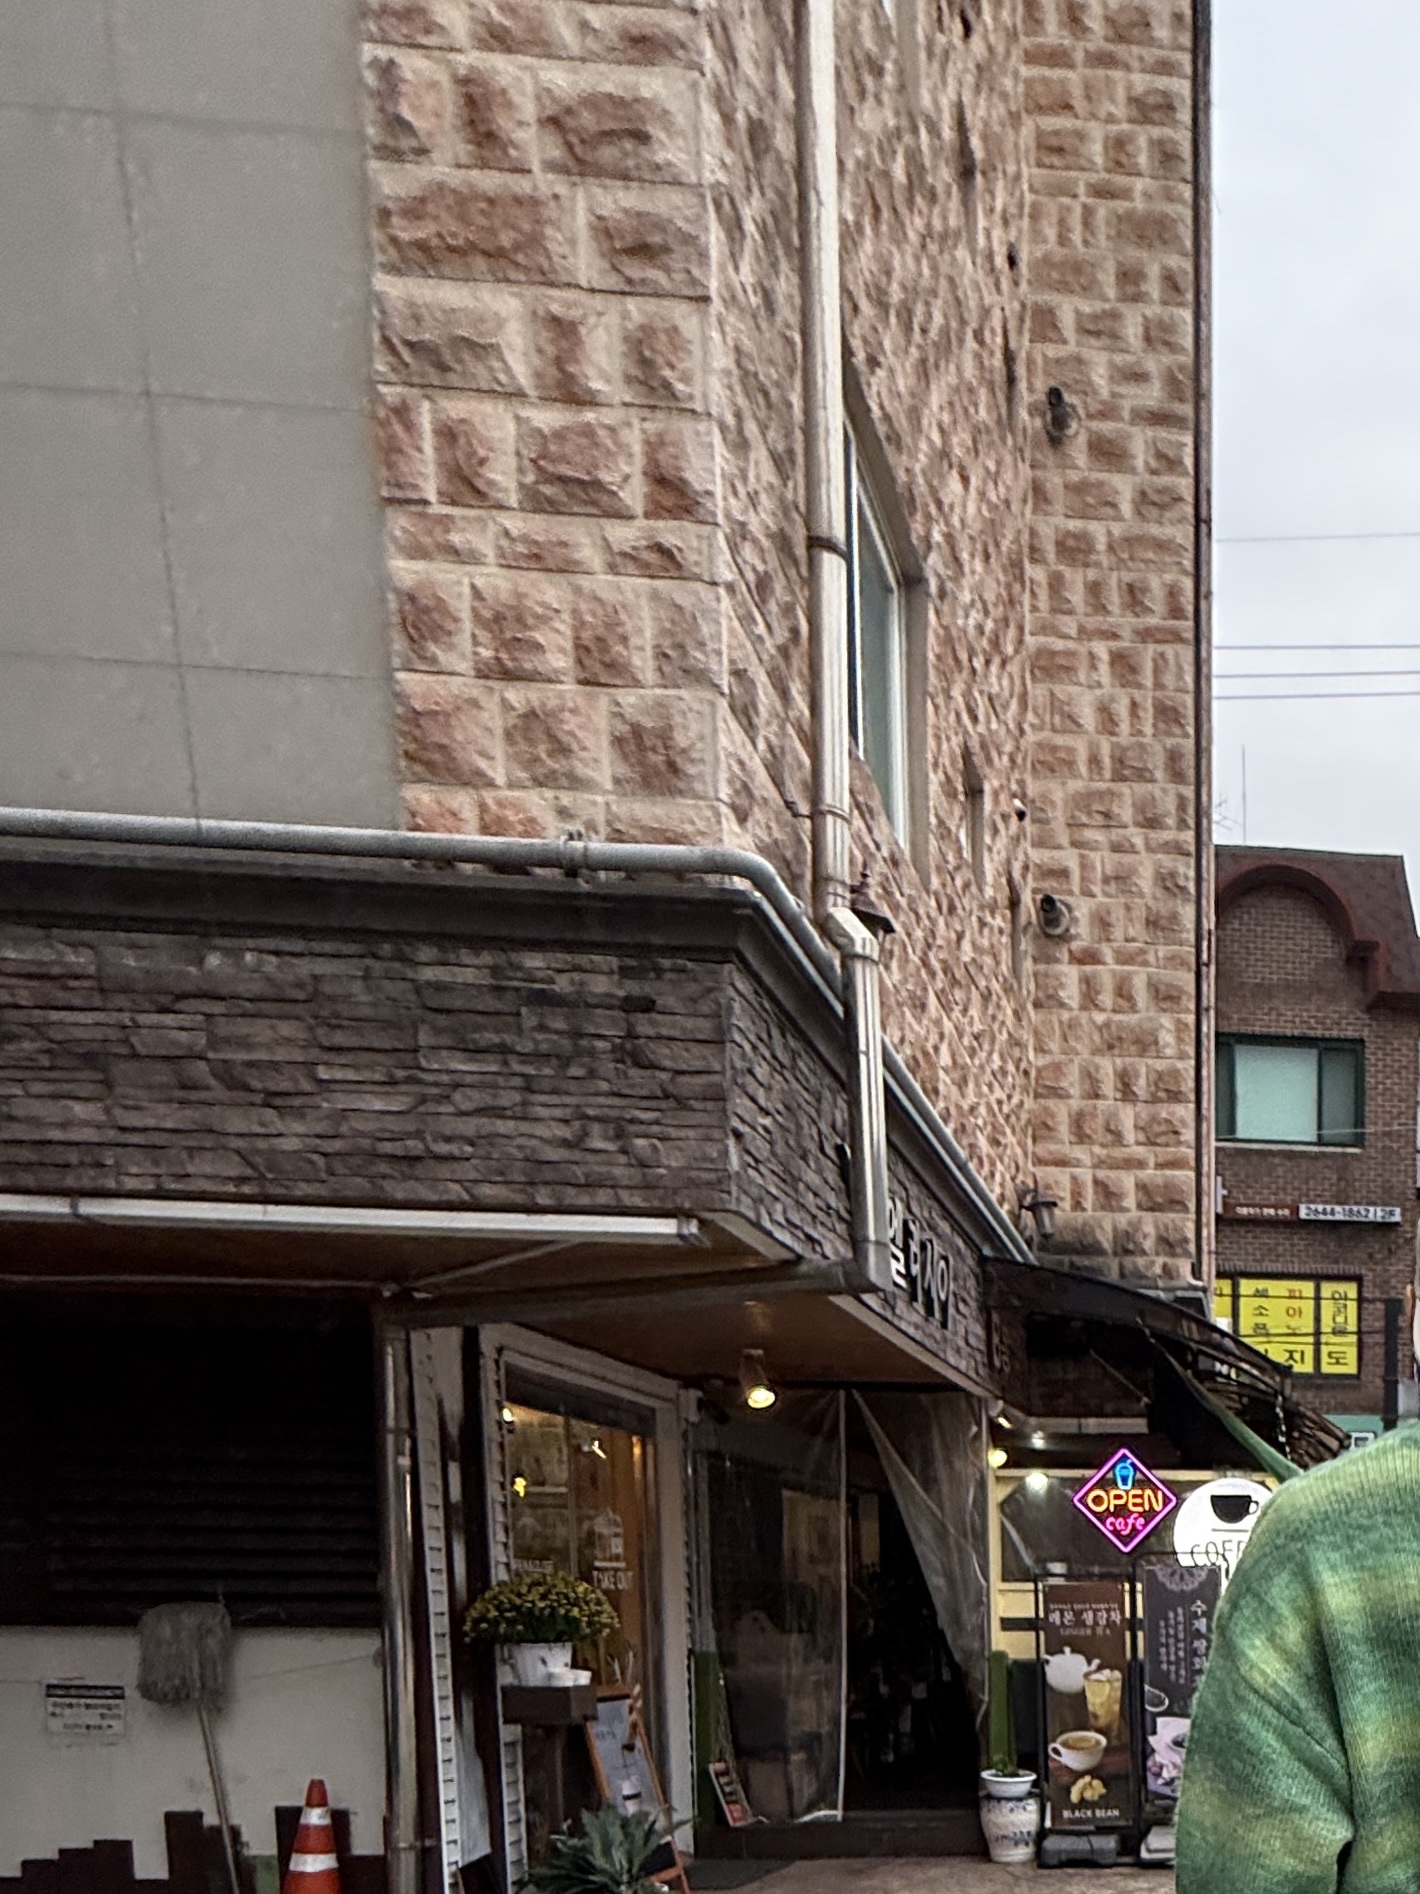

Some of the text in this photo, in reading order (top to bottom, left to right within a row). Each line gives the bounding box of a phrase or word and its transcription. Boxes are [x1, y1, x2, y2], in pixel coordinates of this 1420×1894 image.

[1285, 1287, 1304, 1334] 피아노
[1086, 1488, 1164, 1513] OPEN
[1105, 1513, 1146, 1536] cafe
[1190, 1600, 1208, 1634] 수제
[1062, 1808, 1120, 1819] BLACK BEAN
